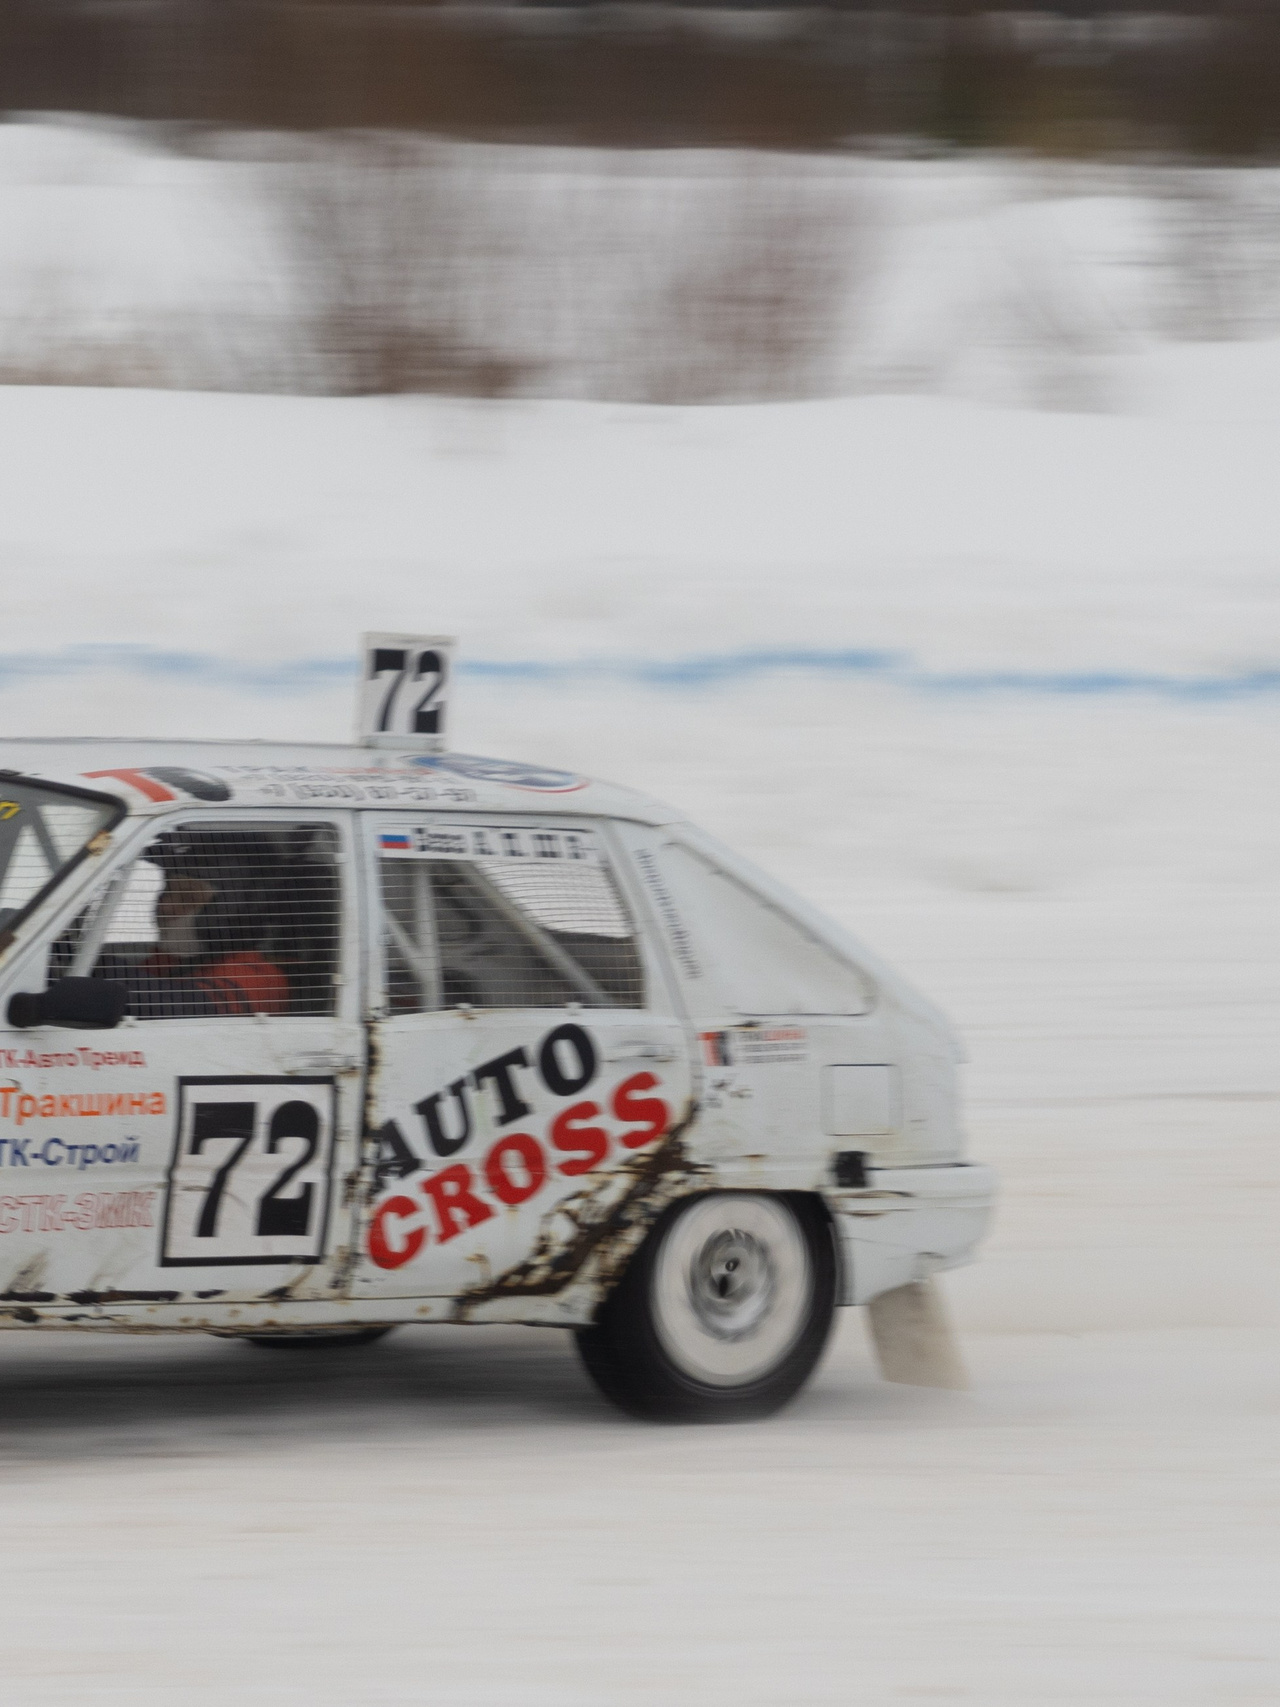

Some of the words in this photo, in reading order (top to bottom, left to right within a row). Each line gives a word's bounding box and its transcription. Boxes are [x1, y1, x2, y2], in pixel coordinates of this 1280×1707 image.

[368, 648, 443, 734] 72
[189, 1100, 320, 1238] 72
[366, 1070, 671, 1270] CROSS
[368, 1022, 598, 1195] AUTO
